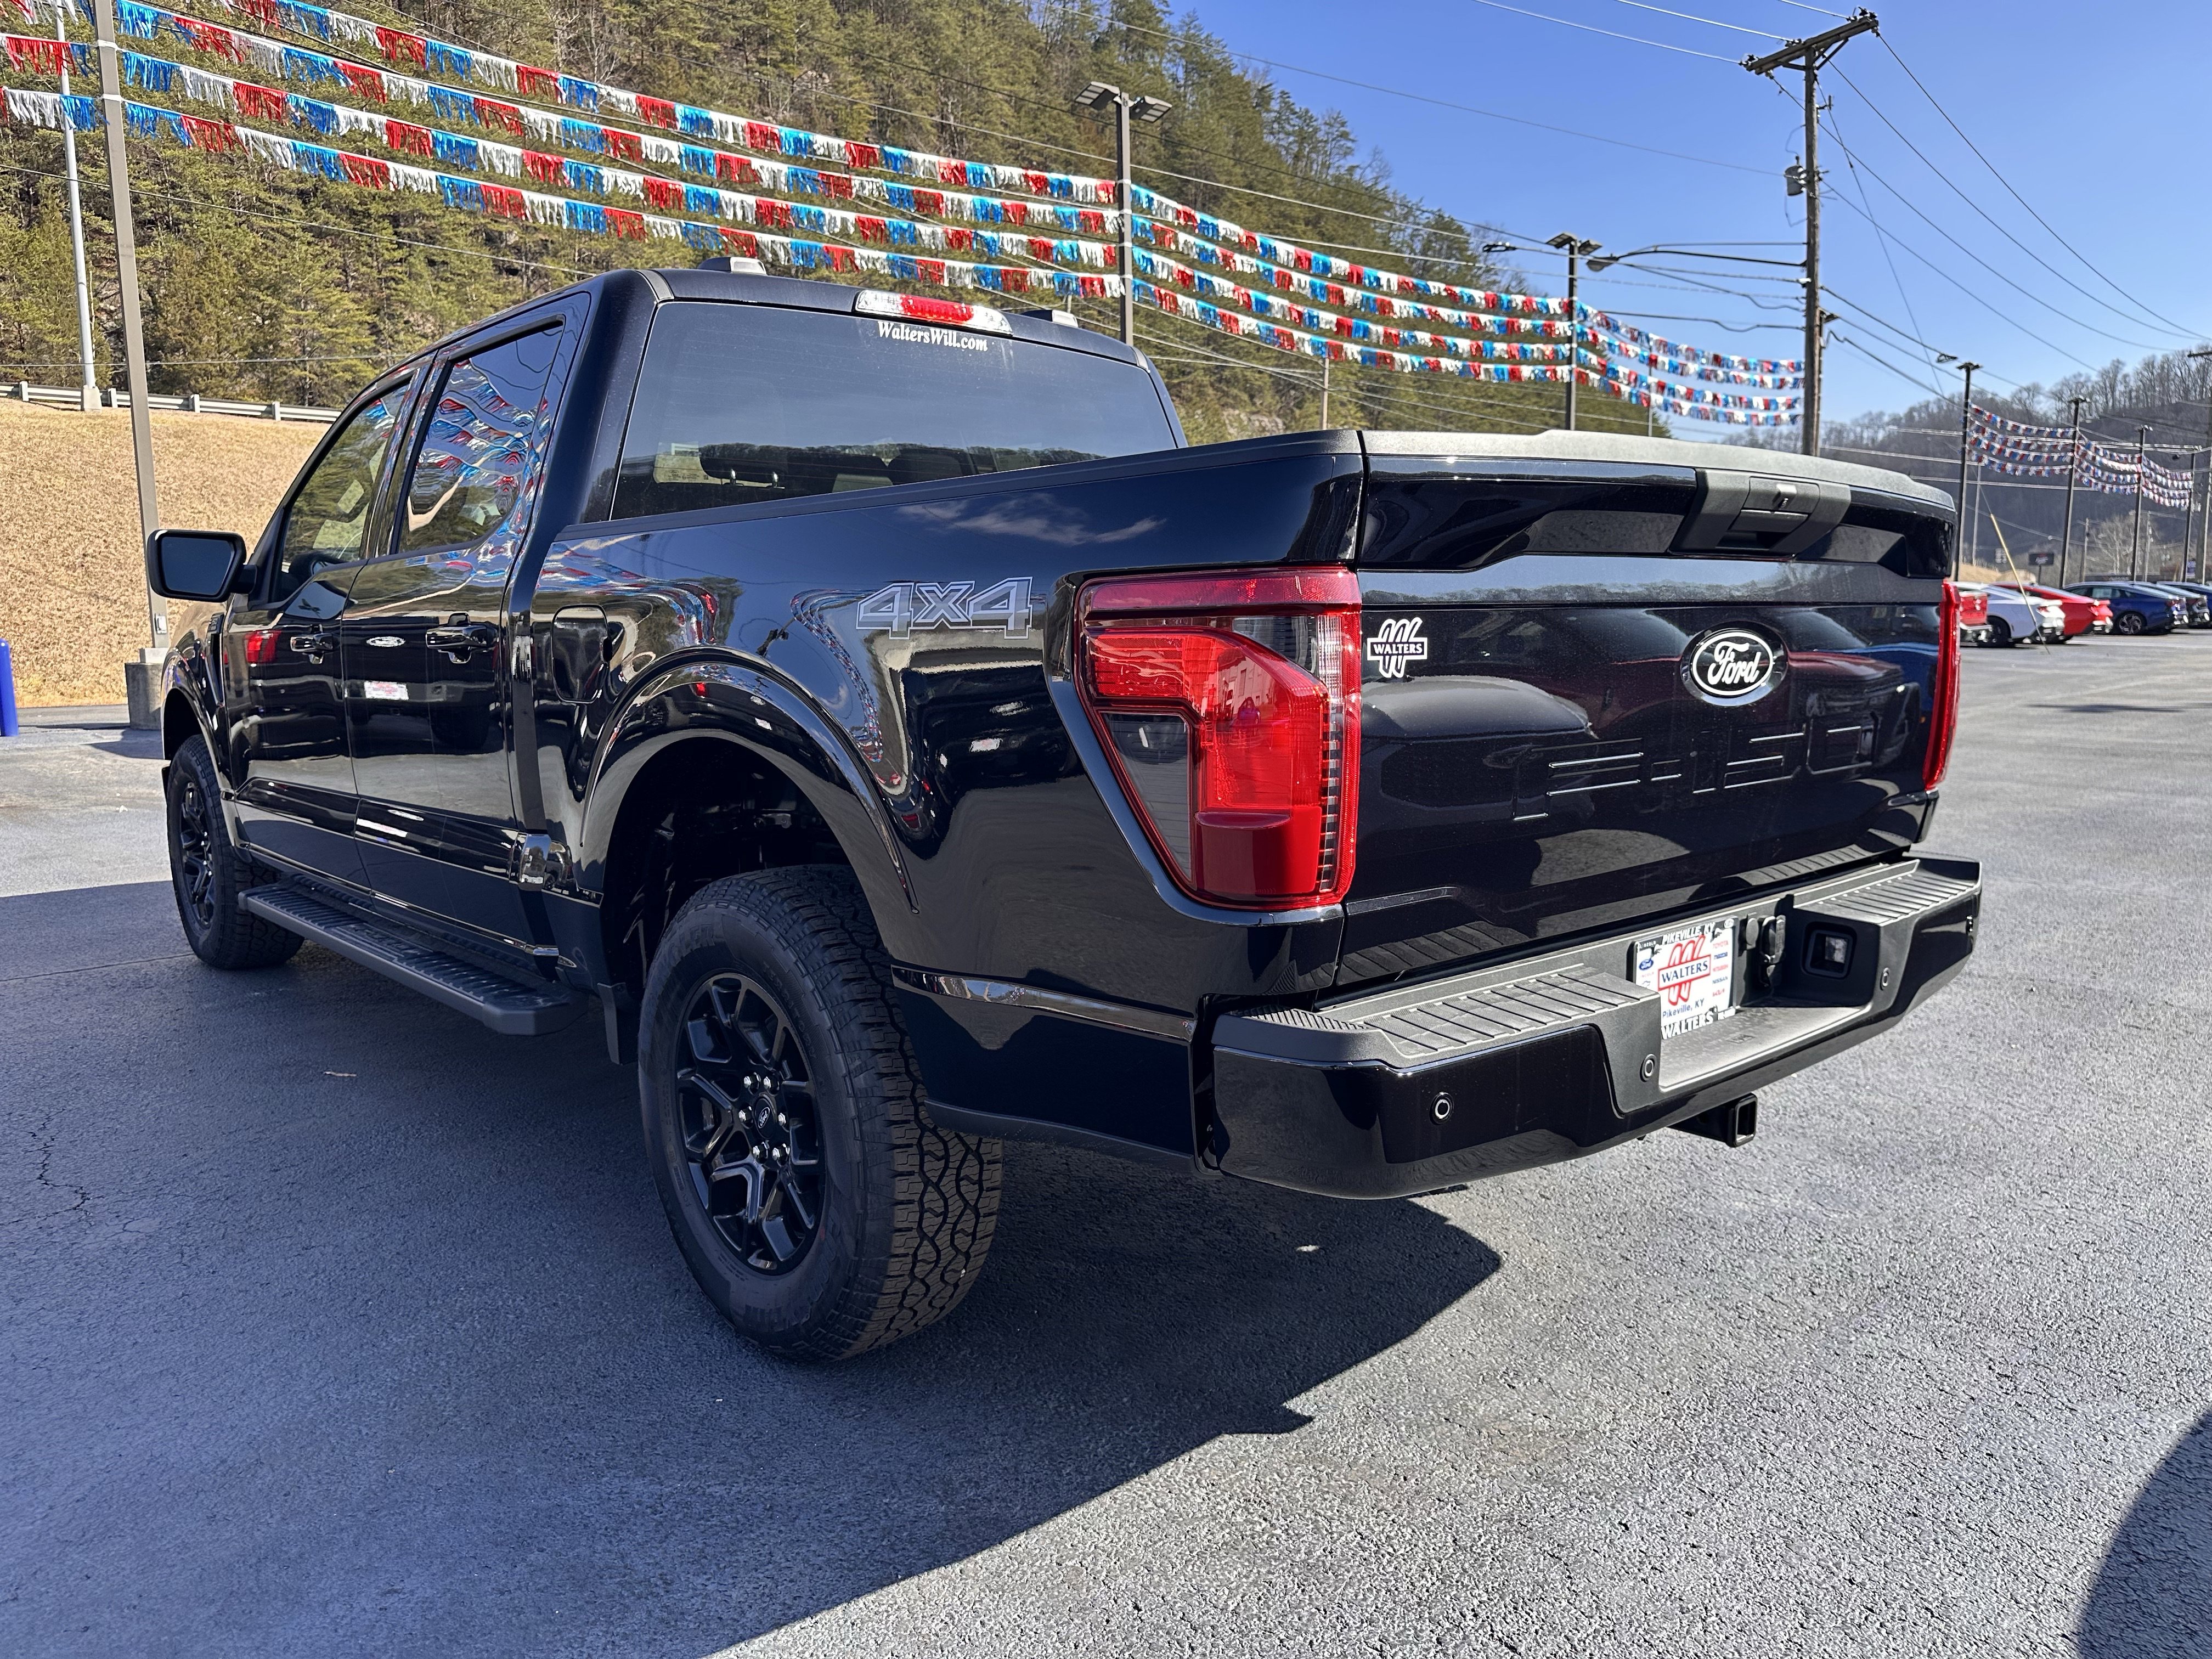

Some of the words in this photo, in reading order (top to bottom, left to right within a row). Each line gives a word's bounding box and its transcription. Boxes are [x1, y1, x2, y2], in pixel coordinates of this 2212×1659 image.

[878, 321, 988, 352] WaltersWill.com
[1373, 644, 1423, 654] WALTERS
[1707, 641, 1762, 685] Ford
[1704, 922, 1716, 935] KY
[1661, 960, 1708, 983] WALTERS
[1663, 1004, 1692, 1019] Pikeville,
[1695, 998, 1705, 1008] KY
[1661, 1011, 1713, 1040] WALTERS
